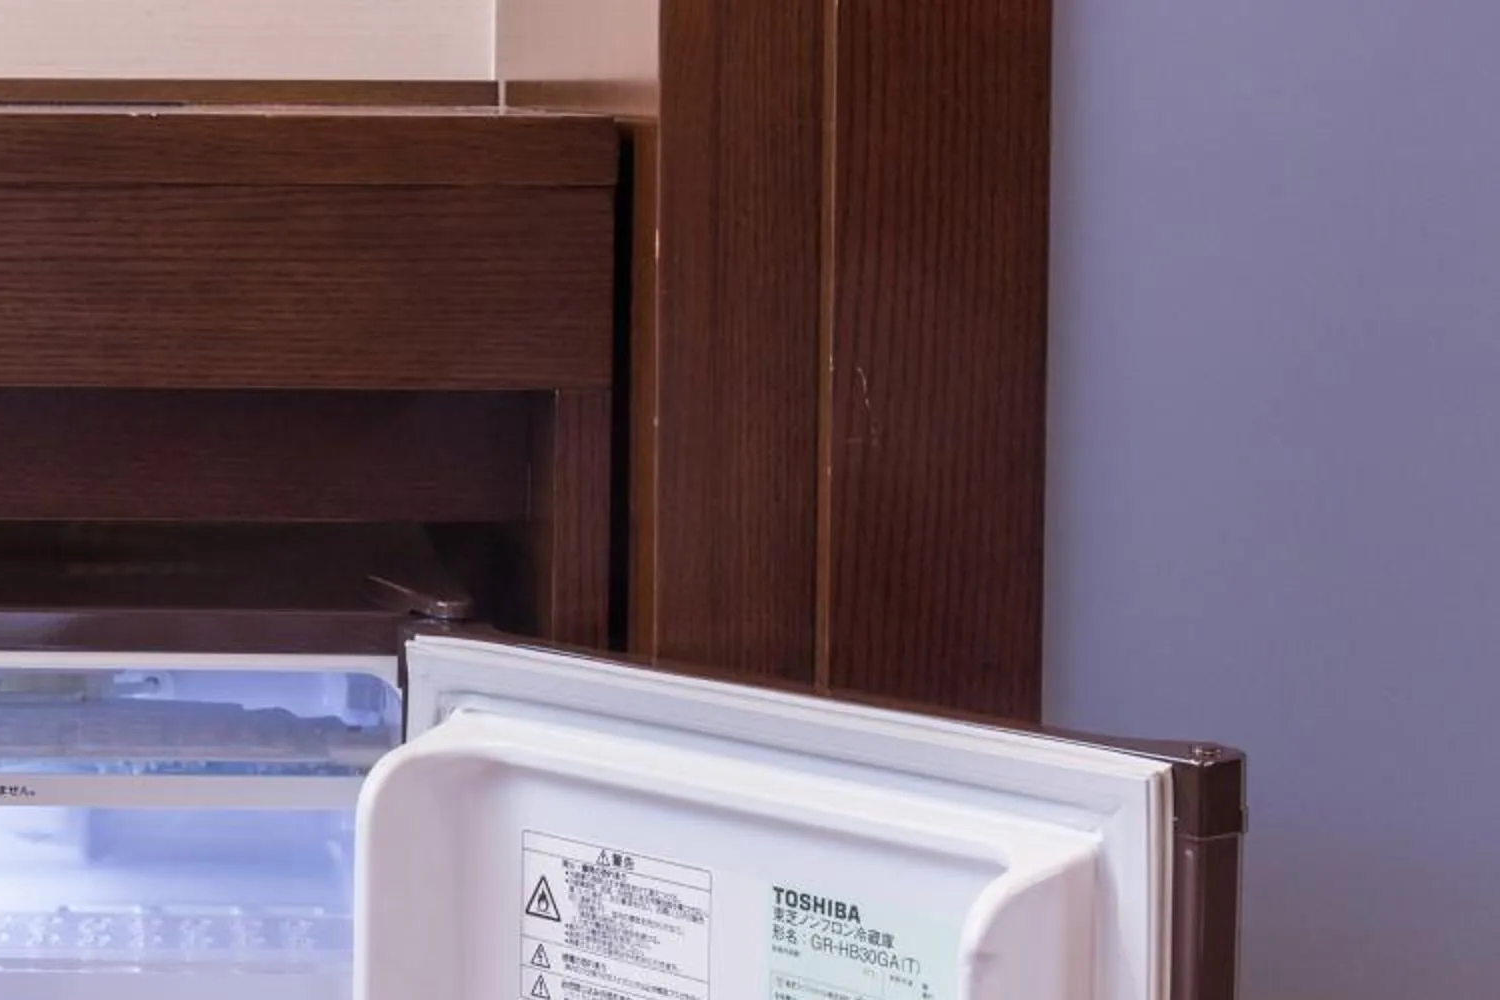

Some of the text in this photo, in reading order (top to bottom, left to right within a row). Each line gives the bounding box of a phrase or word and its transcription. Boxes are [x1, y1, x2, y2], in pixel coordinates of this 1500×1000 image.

[772, 885, 861, 924] TOSHIBA
[772, 906, 896, 950] 東芝ノンフロン冷蔵庫
